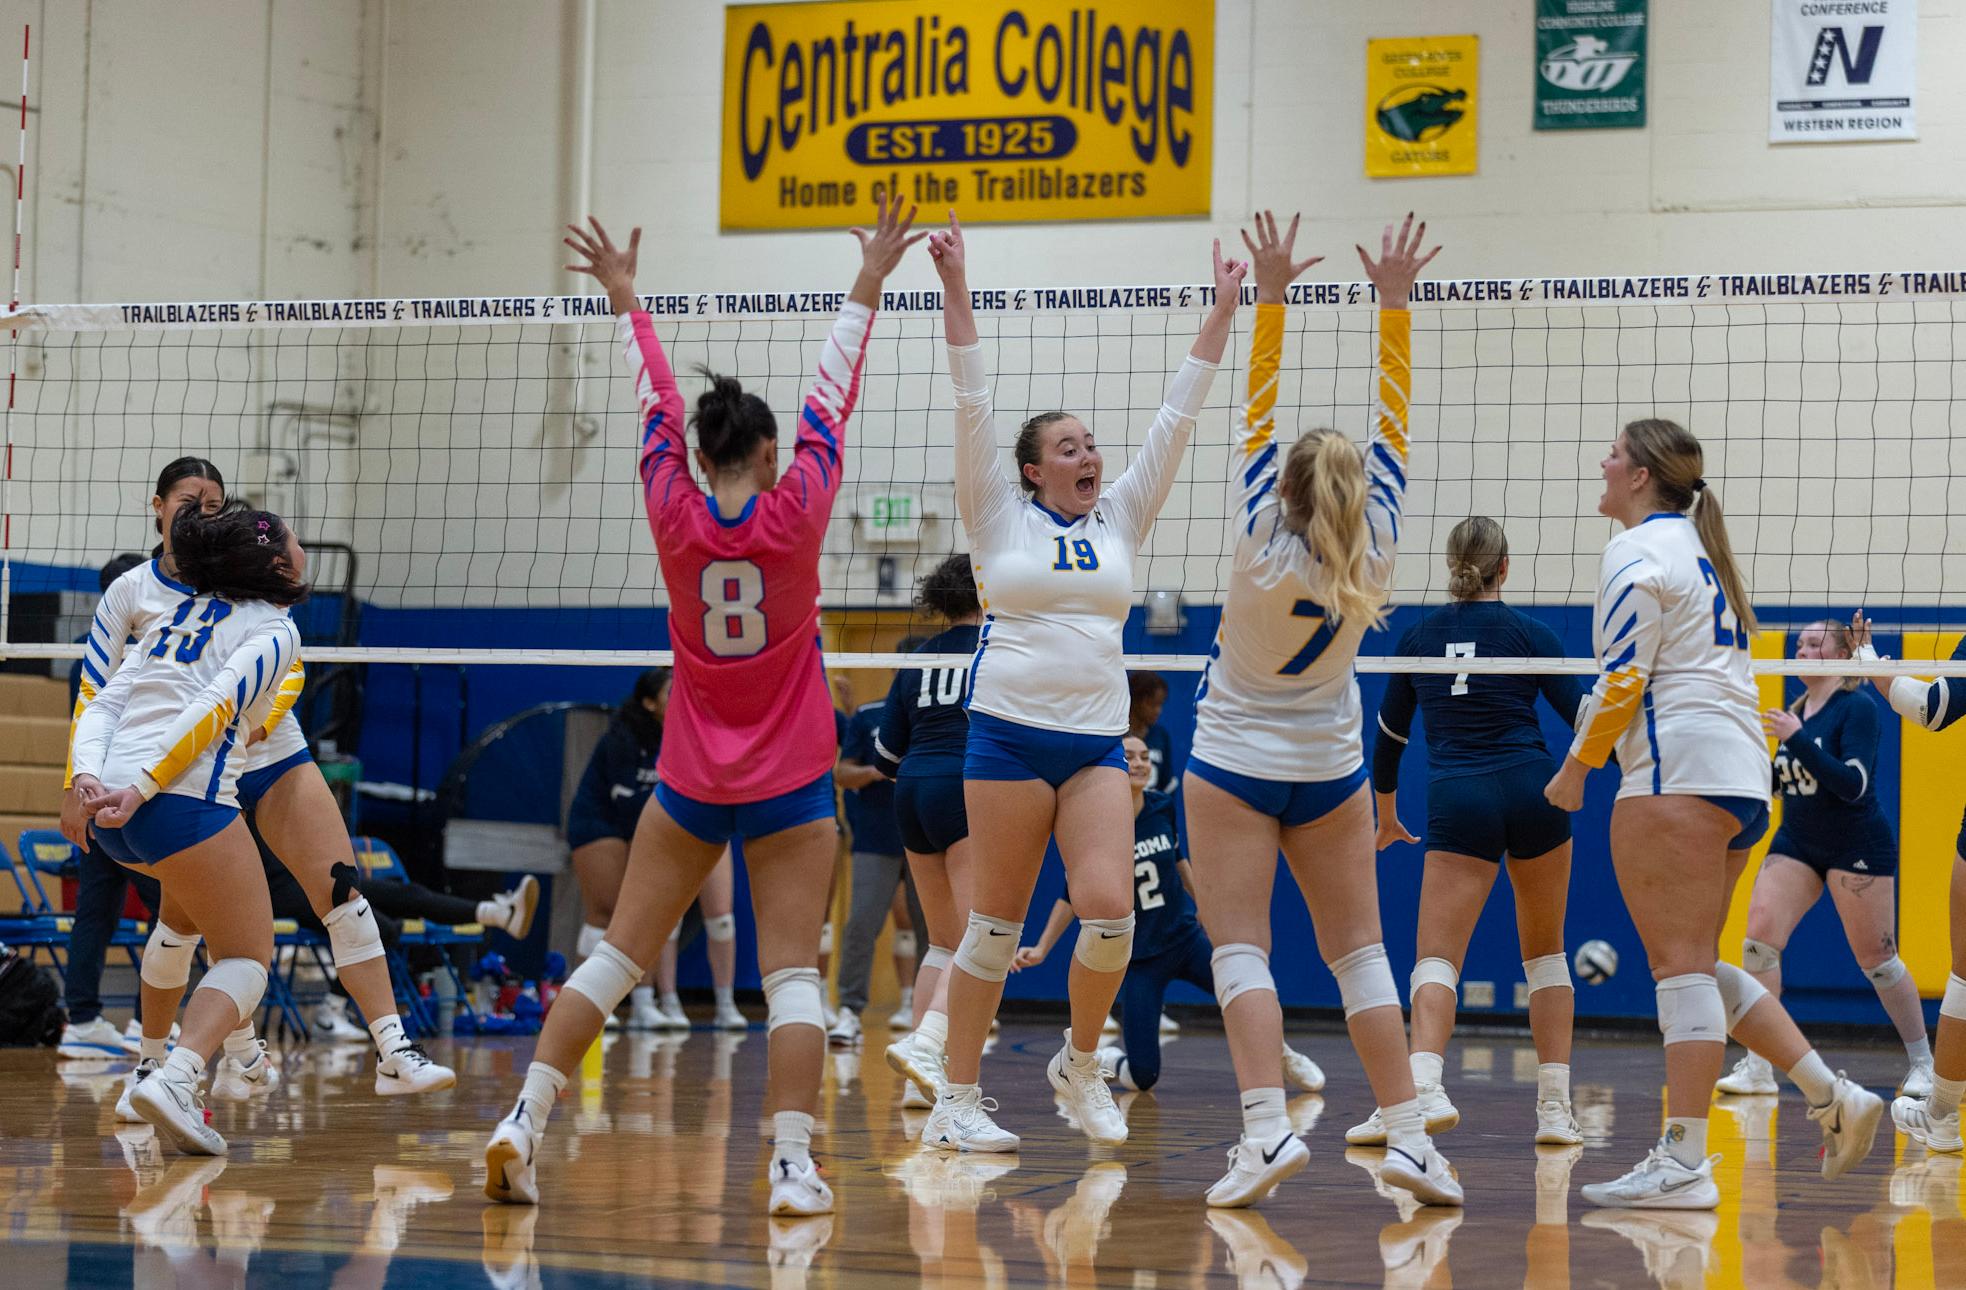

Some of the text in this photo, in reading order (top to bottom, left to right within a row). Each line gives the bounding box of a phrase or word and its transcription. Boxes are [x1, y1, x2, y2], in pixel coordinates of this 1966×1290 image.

[1800, 2, 1888, 16] CONFERENCE
[1806, 26, 1884, 86] N
[740, 9, 1194, 182] Centralia College
[866, 119, 1056, 160] EST. 1925
[1784, 117, 1902, 131] WESTERN REGION
[779, 167, 1147, 208] Home of the Trailblazers
[122, 303, 240, 323] TRAILBLAZERS
[265, 302, 386, 321] TRAILBLAZERS
[411, 299, 535, 318] TRAILBLAZERS
[561, 295, 689, 316] TRAILZERS
[715, 293, 845, 313] TRAILBLAZERS
[877, 290, 1006, 311] RAILBLERS
[1034, 287, 1171, 309] TRAILBLAZERS
[1200, 284, 1339, 306] TILZERS
[1368, 280, 1512, 303] TILBLAZERS
[1541, 277, 1688, 299] TRAILBLAZERS
[1719, 274, 1869, 296] TRAILBLAZERS
[873, 496, 912, 528] EXIT
[1052, 535, 1100, 571] 19
[699, 558, 768, 658] 8
[1696, 555, 1748, 651] 2
[147, 597, 234, 665] 13
[1277, 597, 1345, 675] 7
[917, 667, 964, 708] 10
[1445, 641, 1476, 696] 7
[1134, 860, 1165, 911] 2
